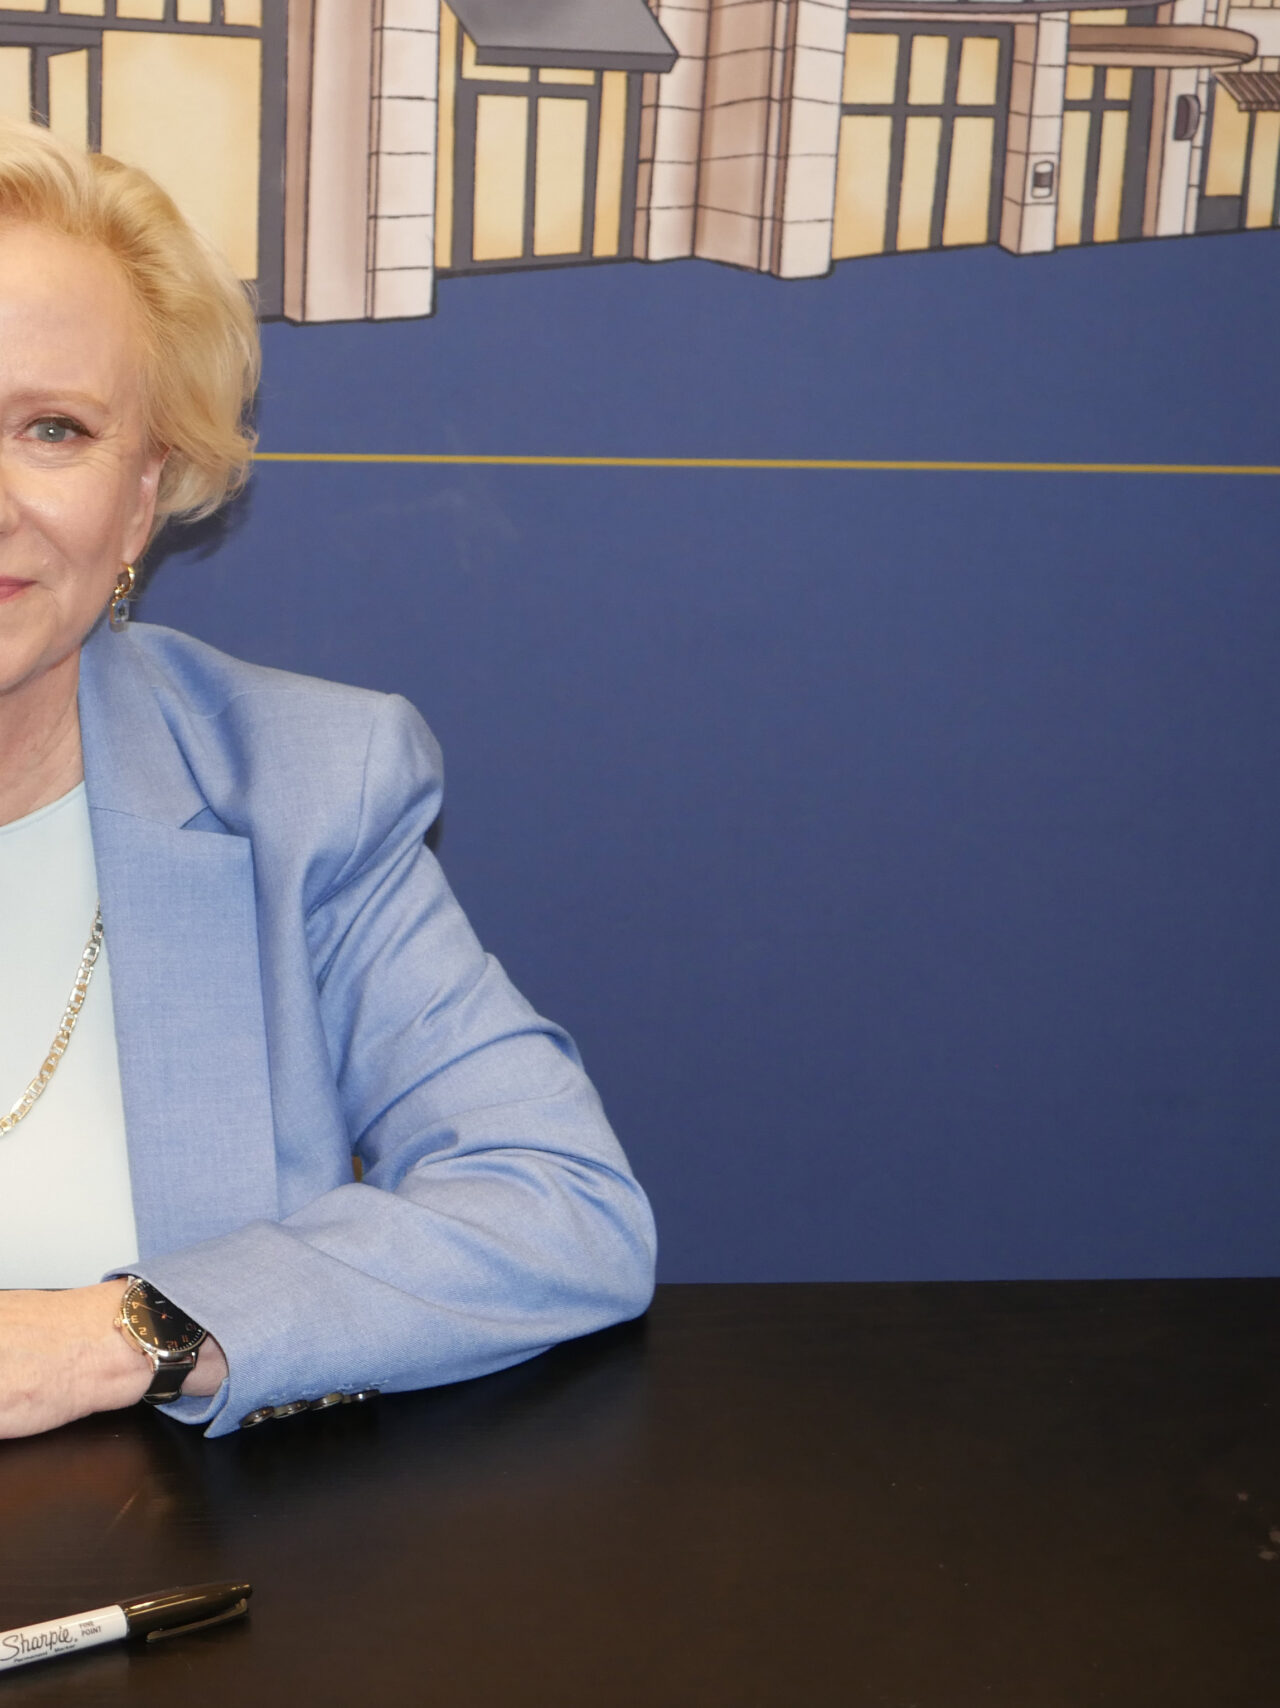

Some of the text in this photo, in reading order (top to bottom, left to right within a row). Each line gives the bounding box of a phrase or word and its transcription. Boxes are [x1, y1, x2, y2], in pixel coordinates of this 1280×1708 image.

[131, 1315, 139, 1323] 3
[138, 1327, 147, 1335] 2
[81, 1626, 101, 1637] POINT
